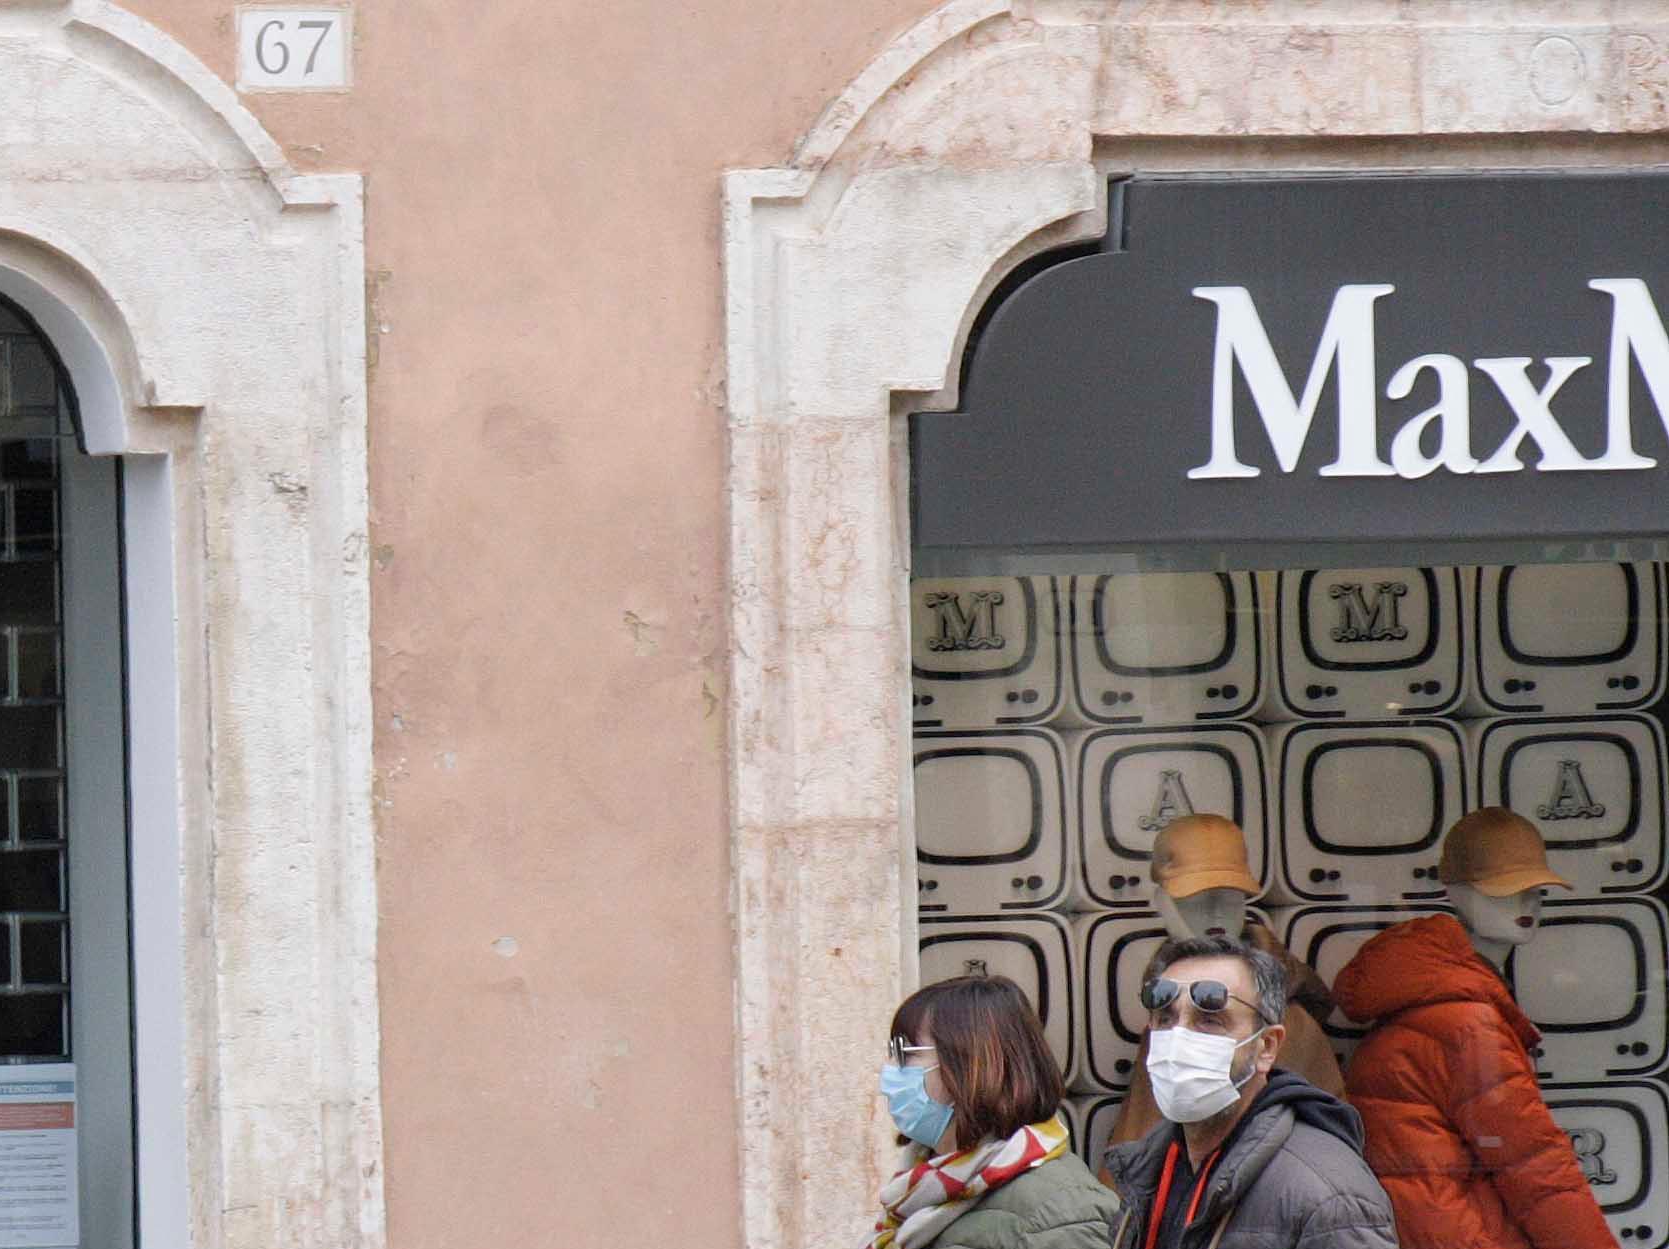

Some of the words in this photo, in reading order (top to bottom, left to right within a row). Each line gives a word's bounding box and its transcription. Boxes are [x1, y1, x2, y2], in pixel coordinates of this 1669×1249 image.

[255, 20, 334, 76] 67
[1329, 582, 1409, 643] M
[1536, 760, 1606, 820] A
